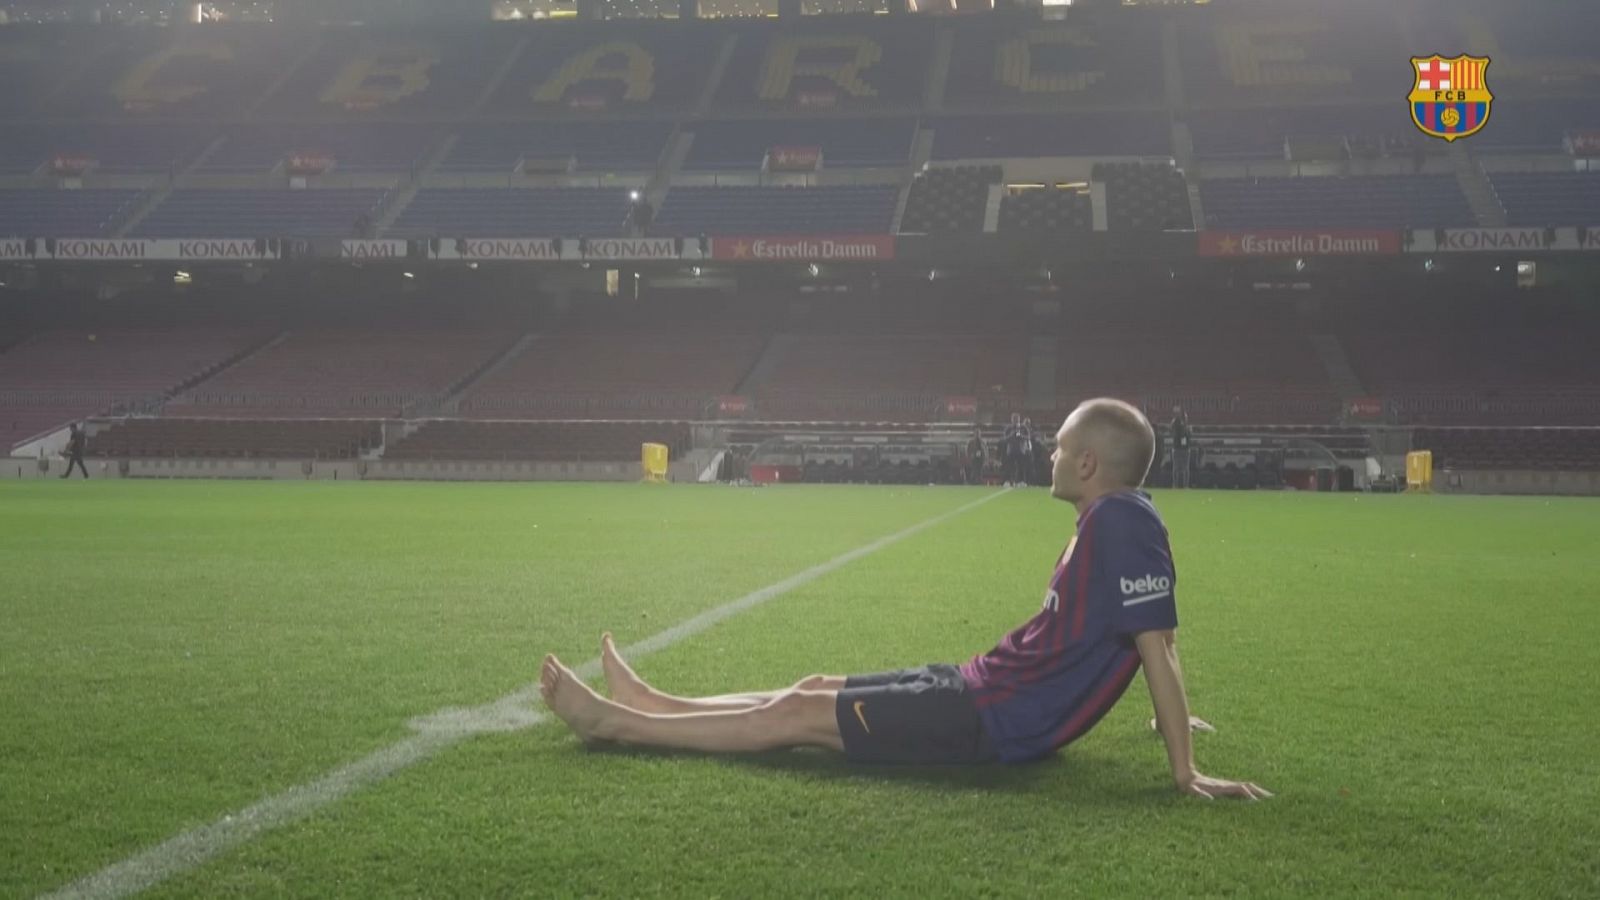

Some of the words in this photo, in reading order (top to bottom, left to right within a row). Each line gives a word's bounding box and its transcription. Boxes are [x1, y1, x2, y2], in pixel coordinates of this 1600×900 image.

[58, 241, 145, 257] KONAMI
[463, 240, 553, 257] KONAMI
[752, 239, 819, 258] Estrella
[820, 240, 877, 258] Damm
[1241, 233, 1315, 254] Estrella
[1317, 233, 1379, 254] Damm
[1120, 573, 1170, 594] beko
